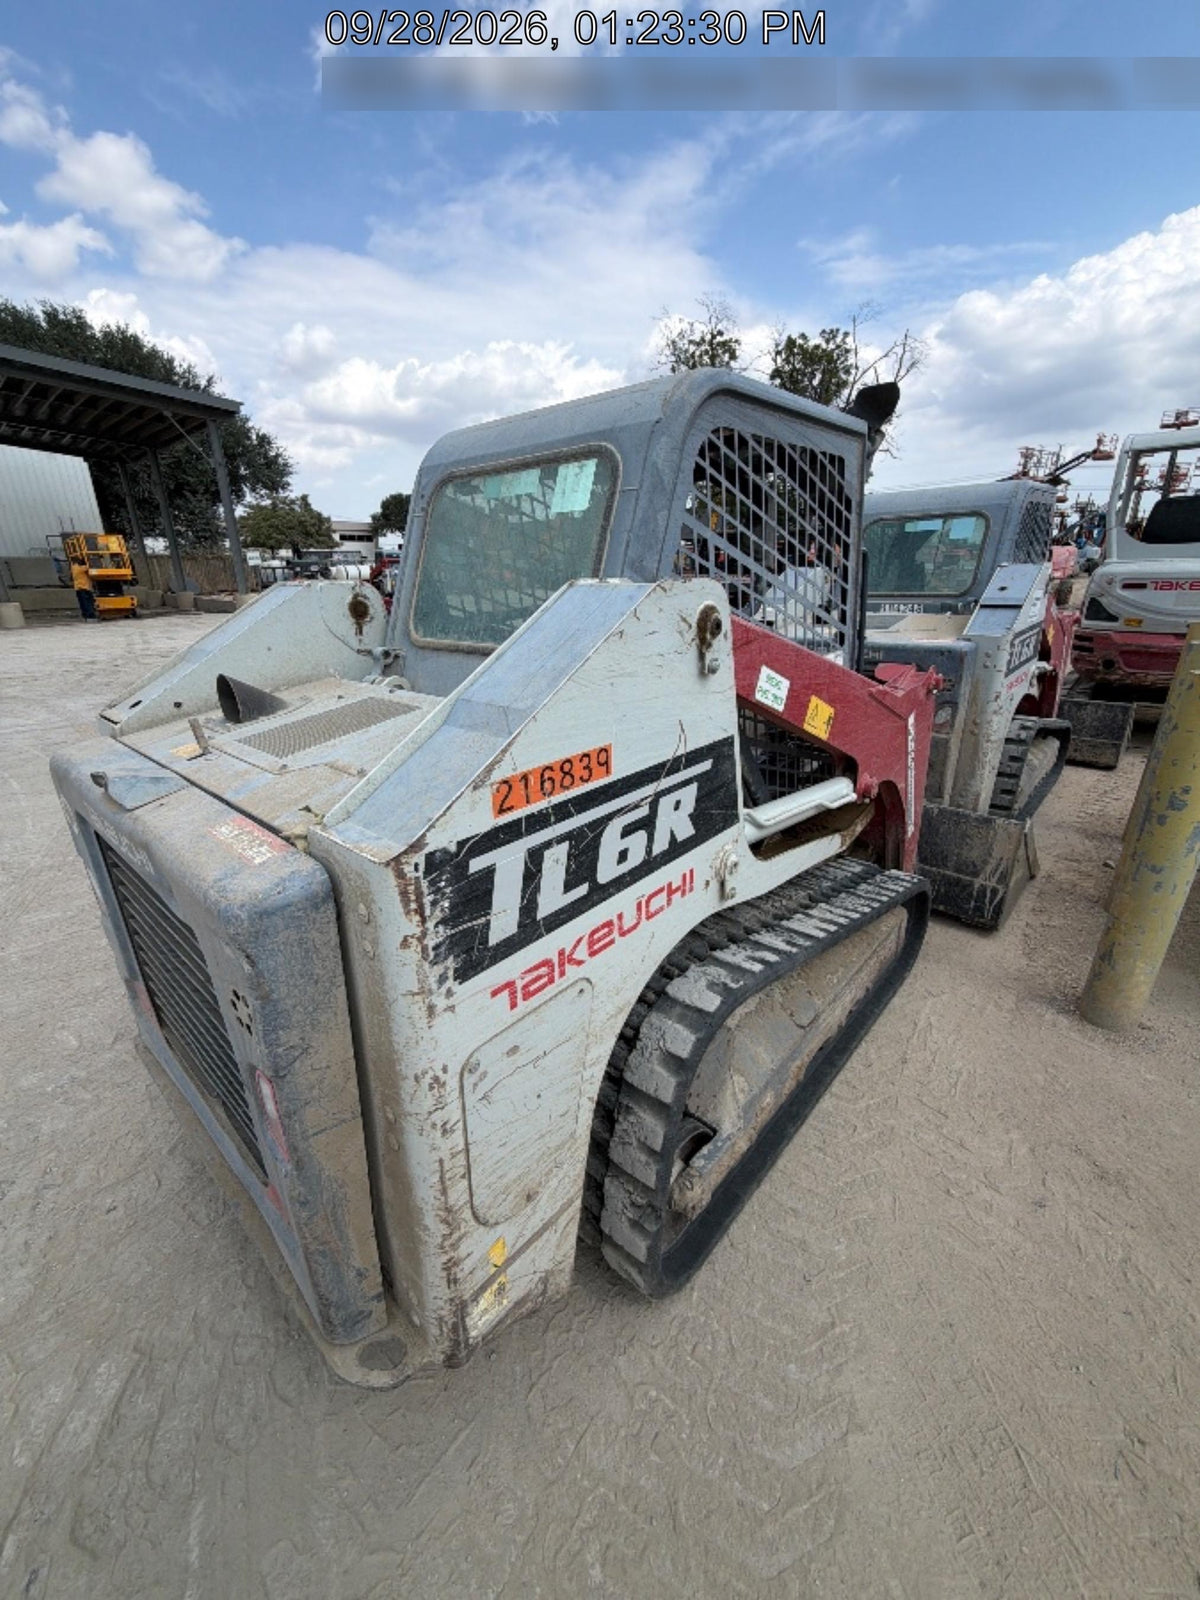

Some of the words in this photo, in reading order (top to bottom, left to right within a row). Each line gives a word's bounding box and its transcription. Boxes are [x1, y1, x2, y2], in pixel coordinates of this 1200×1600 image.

[468, 760, 713, 947] TL6R
[495, 747, 611, 815] 216839
[490, 867, 695, 1012] TAKEUCHI
